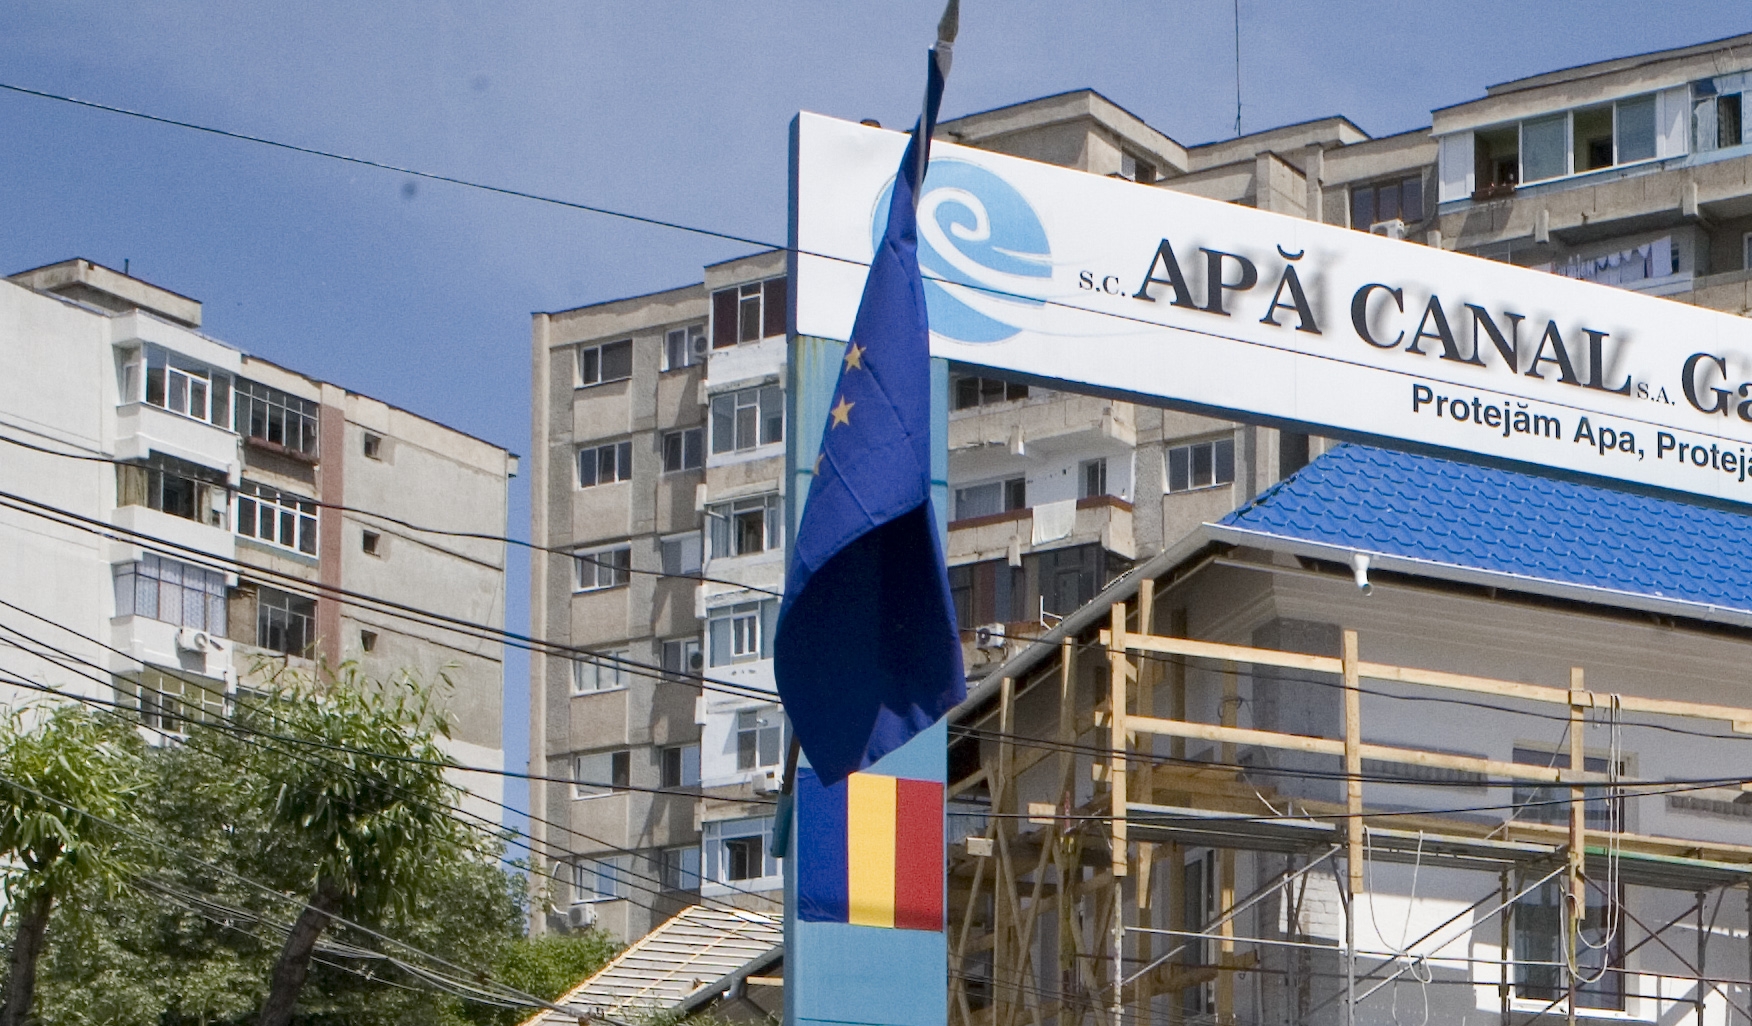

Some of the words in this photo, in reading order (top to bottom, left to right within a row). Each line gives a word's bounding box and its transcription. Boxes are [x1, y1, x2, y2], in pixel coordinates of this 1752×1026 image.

[1132, 237, 1323, 335] APĂ
[1350, 283, 1632, 396] CANAL
[1636, 381, 1675, 406] S.A.
[1412, 384, 1561, 437] Protejăm
[1573, 415, 1645, 462] Apa,
